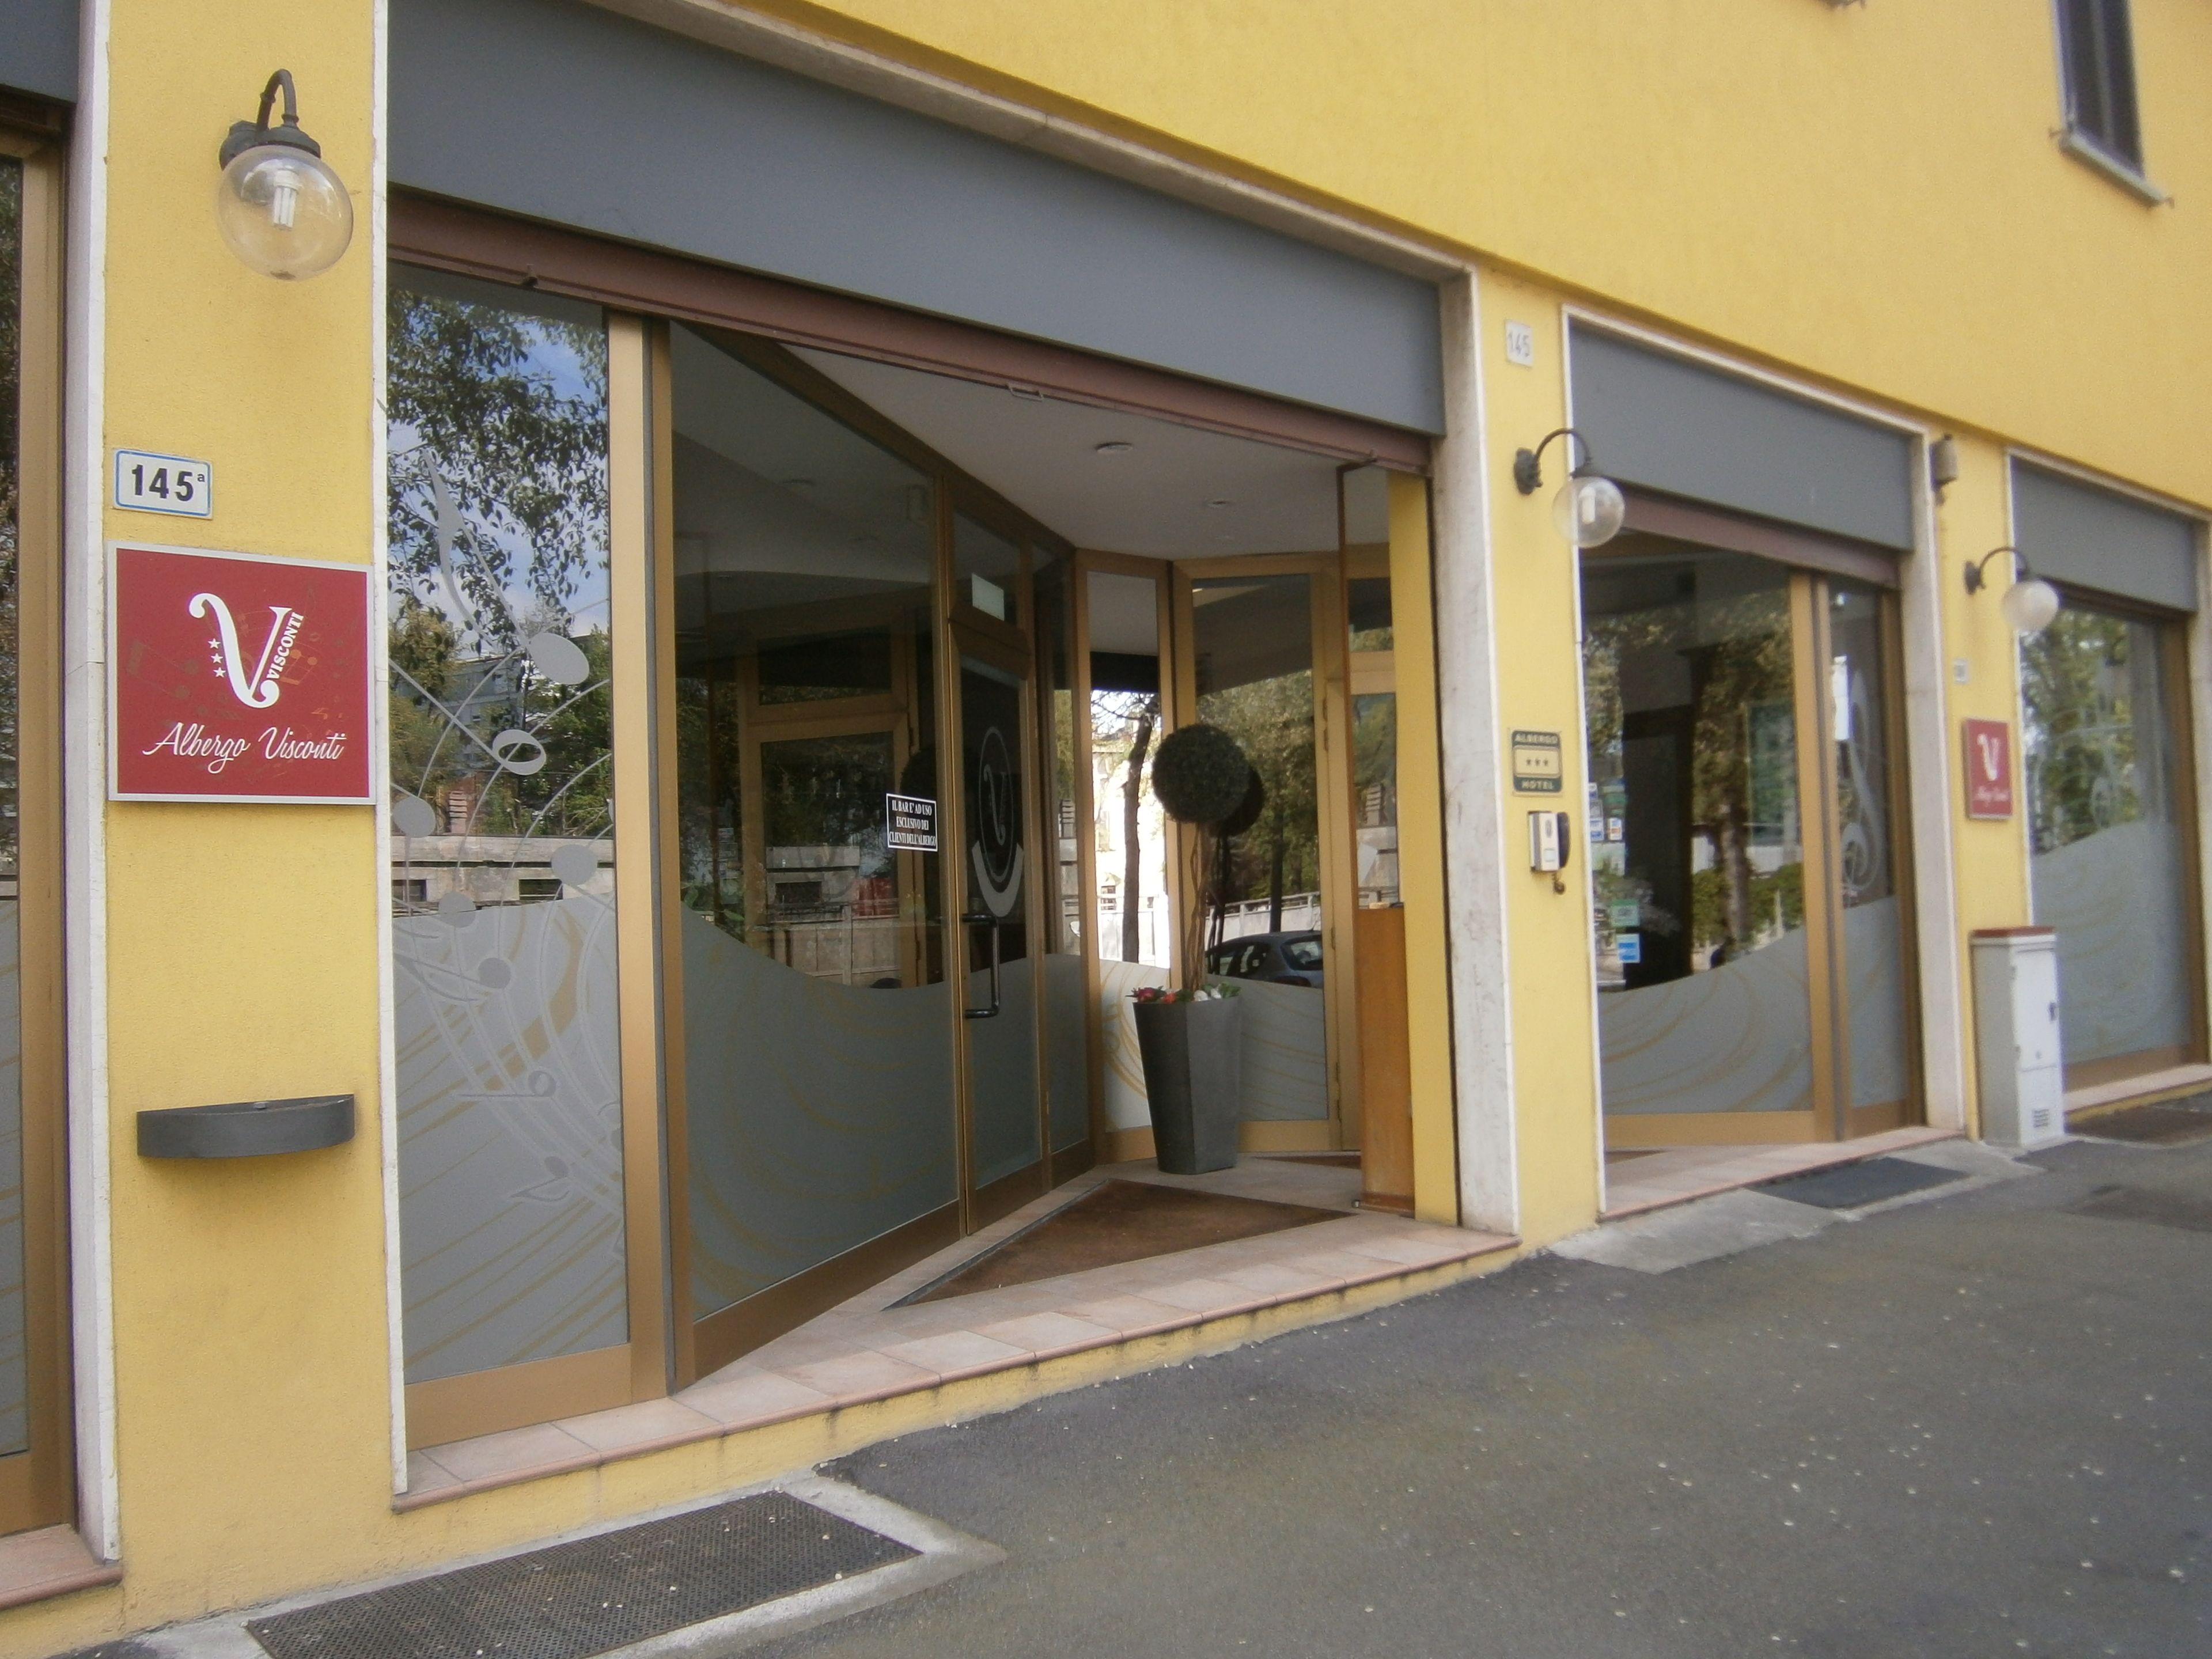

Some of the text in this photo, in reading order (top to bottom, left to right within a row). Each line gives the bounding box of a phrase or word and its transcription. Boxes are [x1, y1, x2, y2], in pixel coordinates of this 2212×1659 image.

[266, 612, 304, 679] VISCONTI
[142, 722, 347, 774] Albergo Visconti
[892, 800, 897, 811] IL
[898, 801, 908, 813] BAR
[915, 804, 922, 815] AD
[922, 804, 932, 816] USO
[896, 816, 929, 831] ESCLUSIVO DEI
[889, 831, 907, 843] CLIENTI
